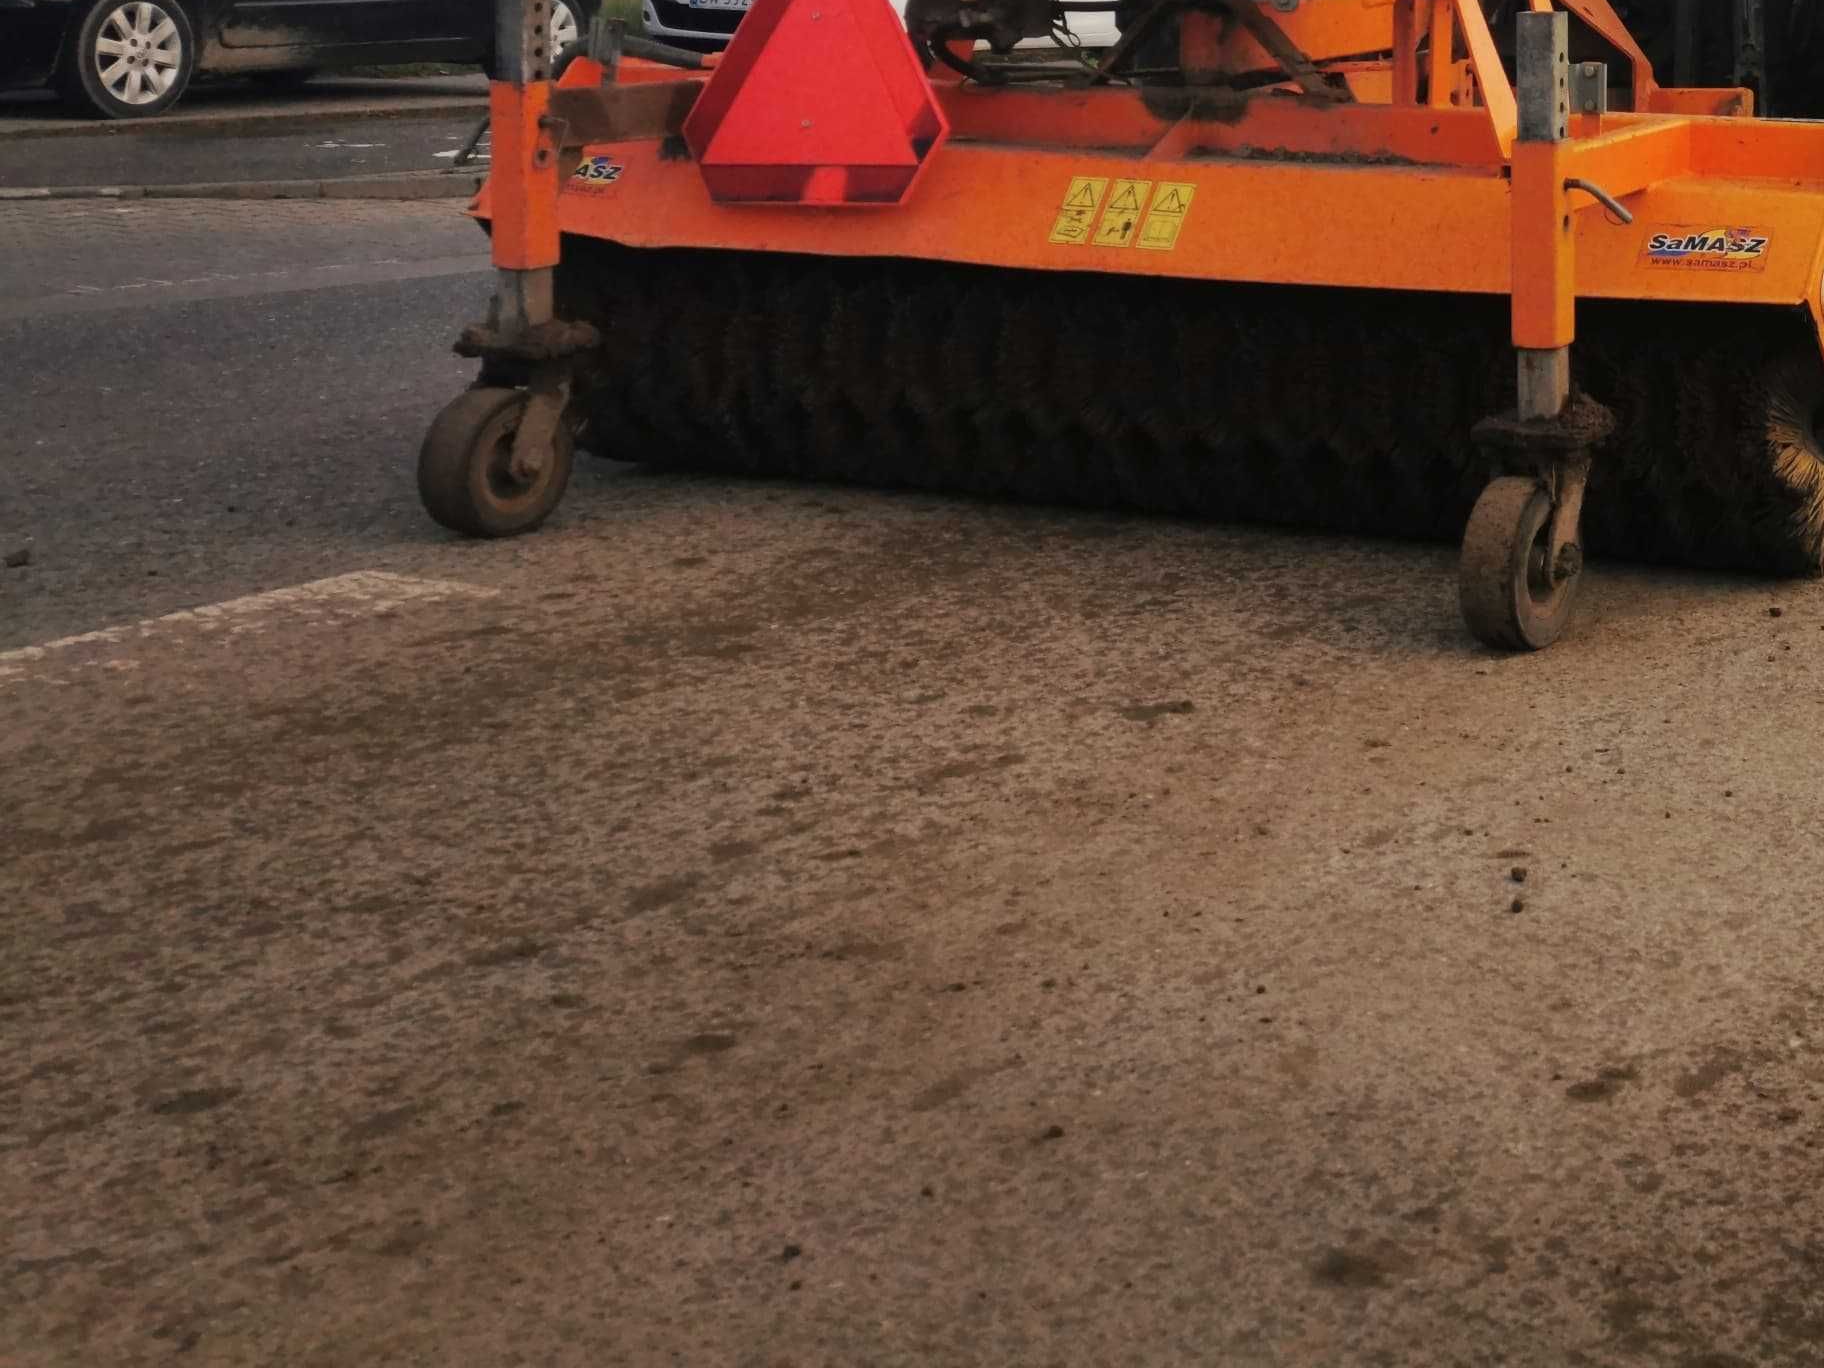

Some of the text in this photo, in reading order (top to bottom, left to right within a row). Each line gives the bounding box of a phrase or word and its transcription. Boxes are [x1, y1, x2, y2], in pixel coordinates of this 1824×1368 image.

[575, 164, 623, 180] ASZ
[1649, 234, 1767, 253] SaMASZ
[1651, 257, 1753, 270] www.samasz.pl
